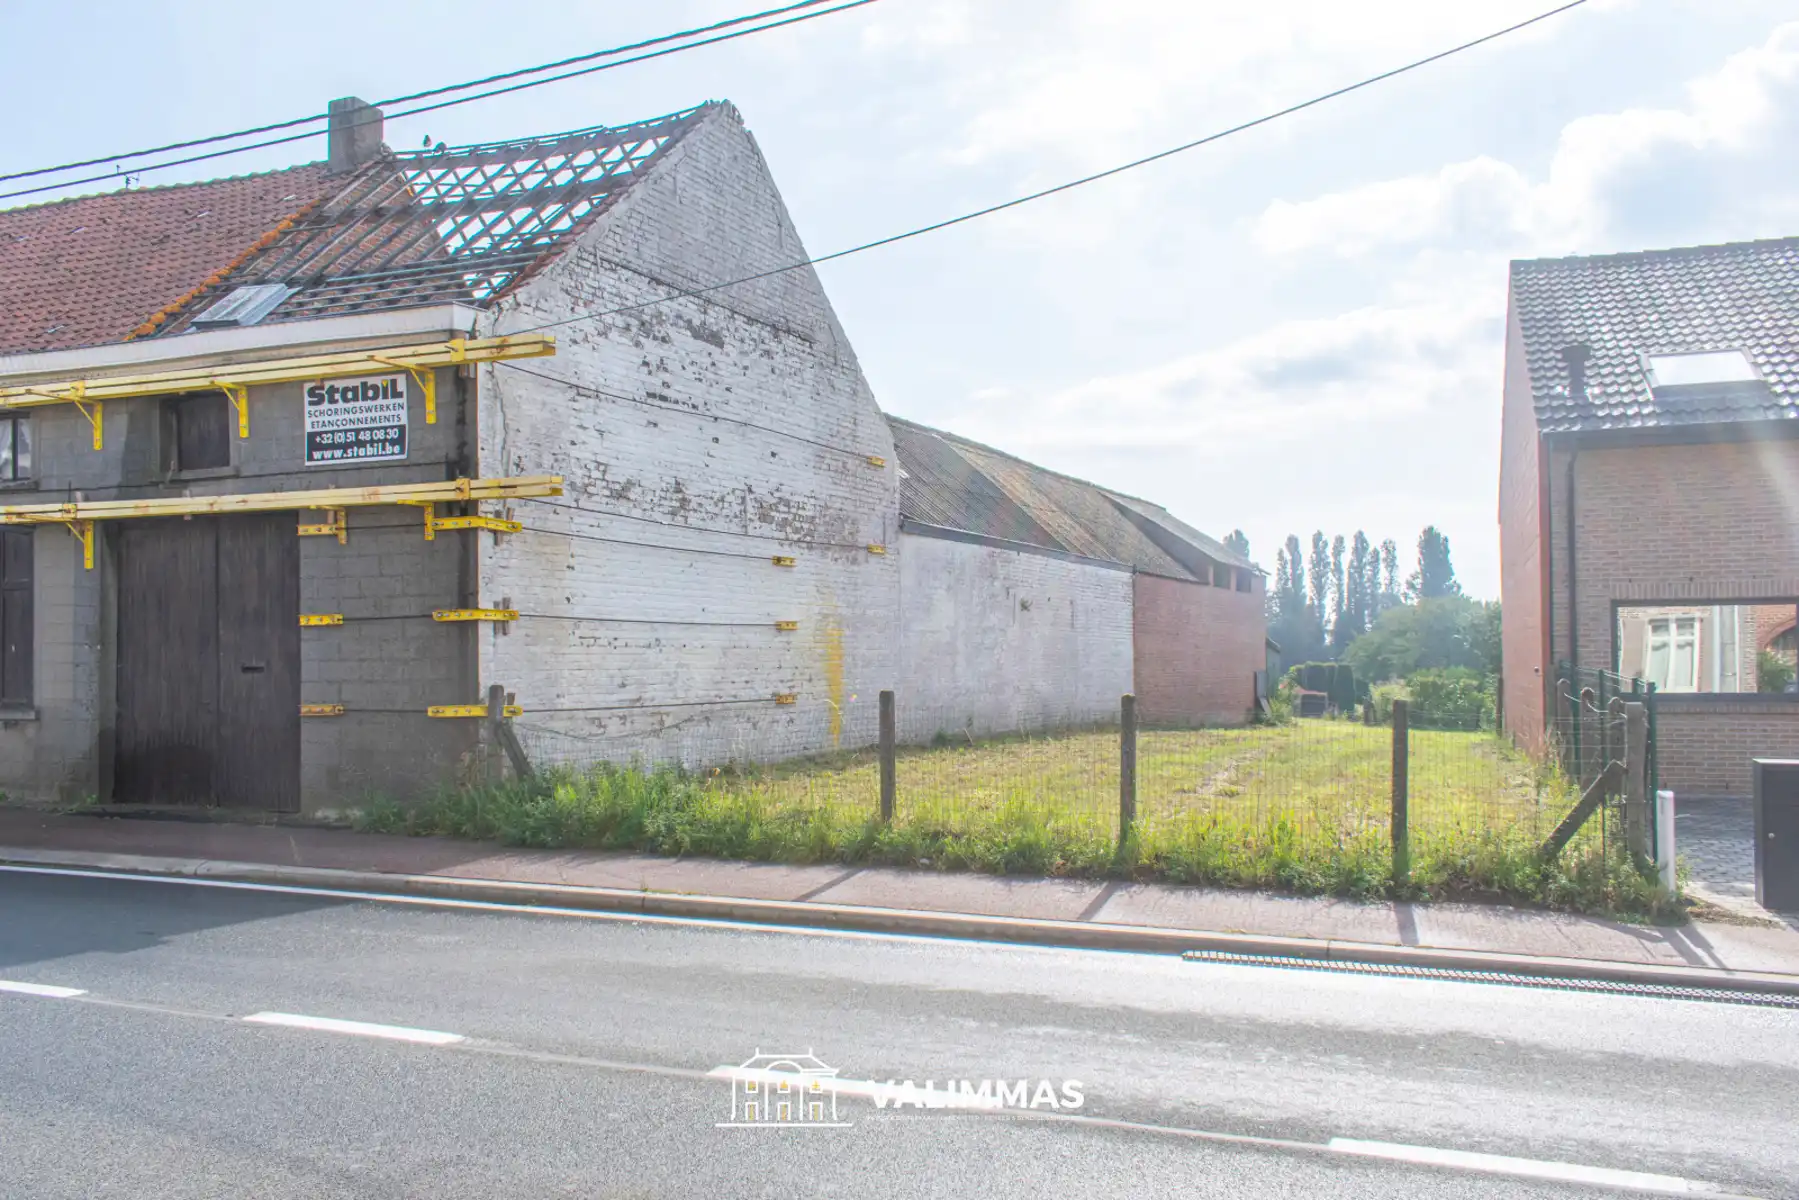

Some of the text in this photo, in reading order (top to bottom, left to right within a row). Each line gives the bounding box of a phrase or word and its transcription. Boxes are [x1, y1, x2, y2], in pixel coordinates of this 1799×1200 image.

[308, 402, 405, 418] SCHORINGSWERKEN
[315, 433, 333, 444] +32
[346, 431, 356, 442] 51
[358, 430, 371, 441] 48
[386, 428, 399, 439] 30
[312, 442, 400, 460] www.stabil.be
